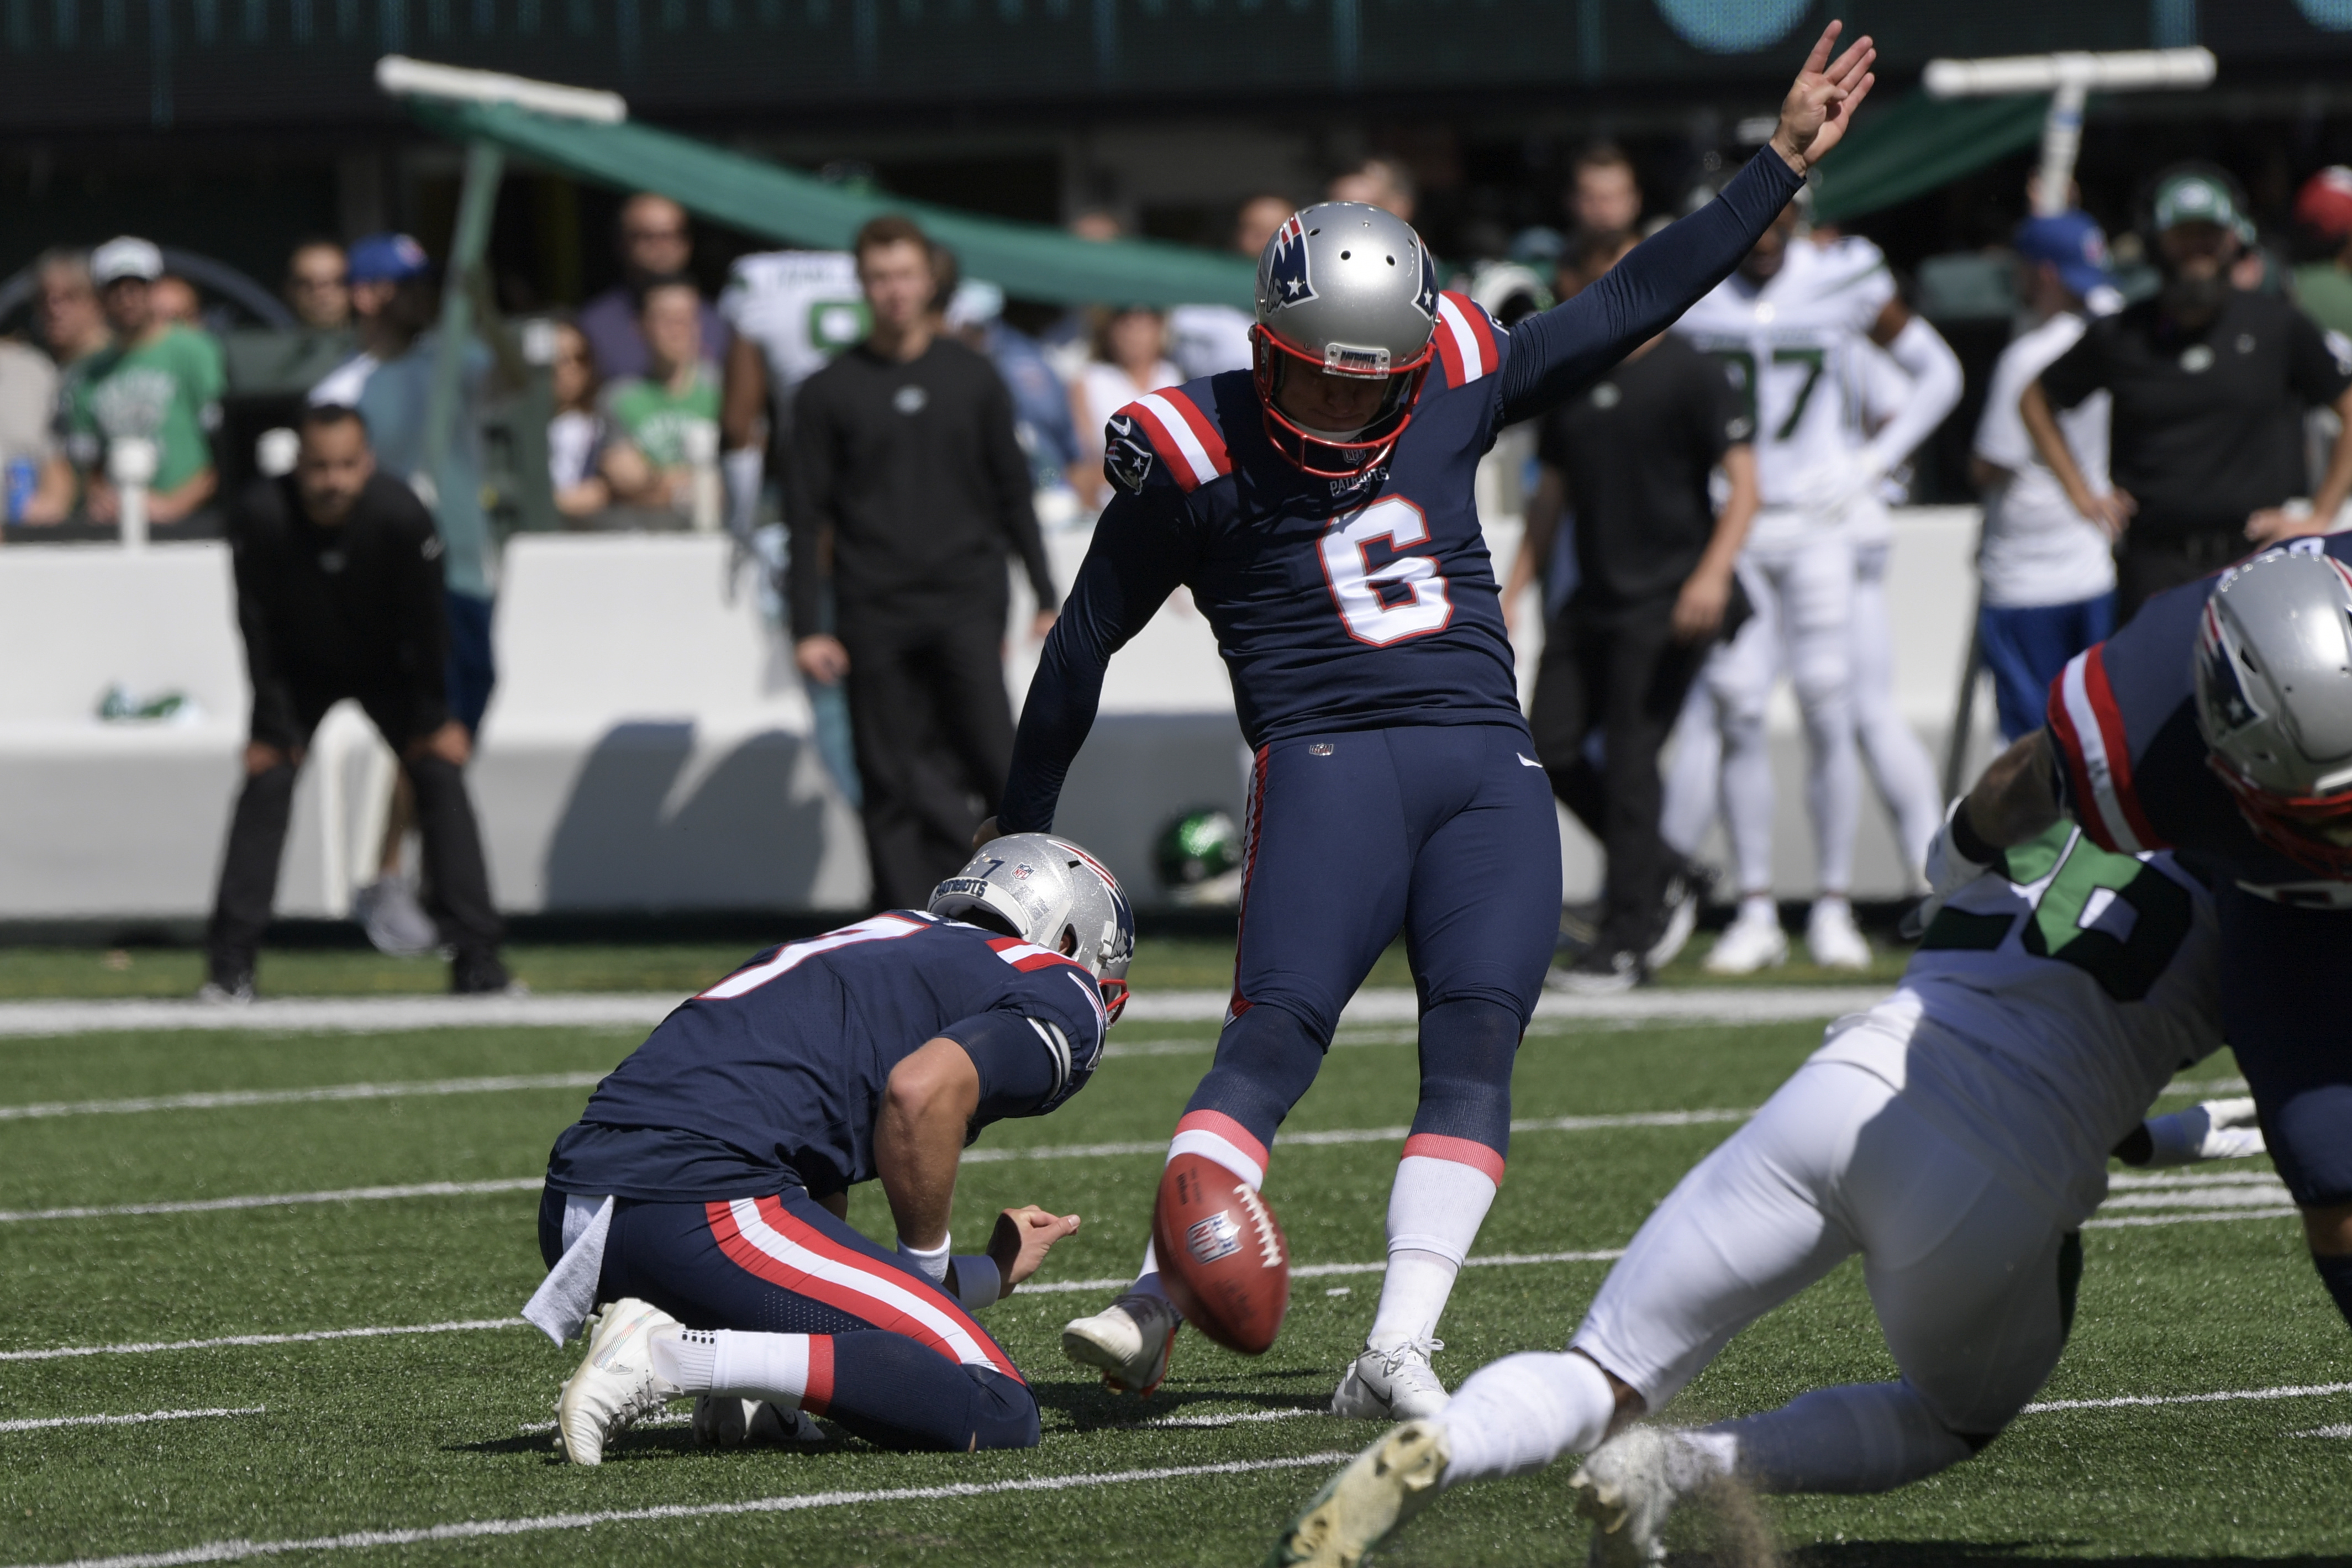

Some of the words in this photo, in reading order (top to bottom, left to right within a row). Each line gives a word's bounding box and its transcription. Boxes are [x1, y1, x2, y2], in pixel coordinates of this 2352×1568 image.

[1316, 493, 1455, 648] 6
[980, 859, 1005, 879] 7
[1013, 868, 1028, 879] NFL
